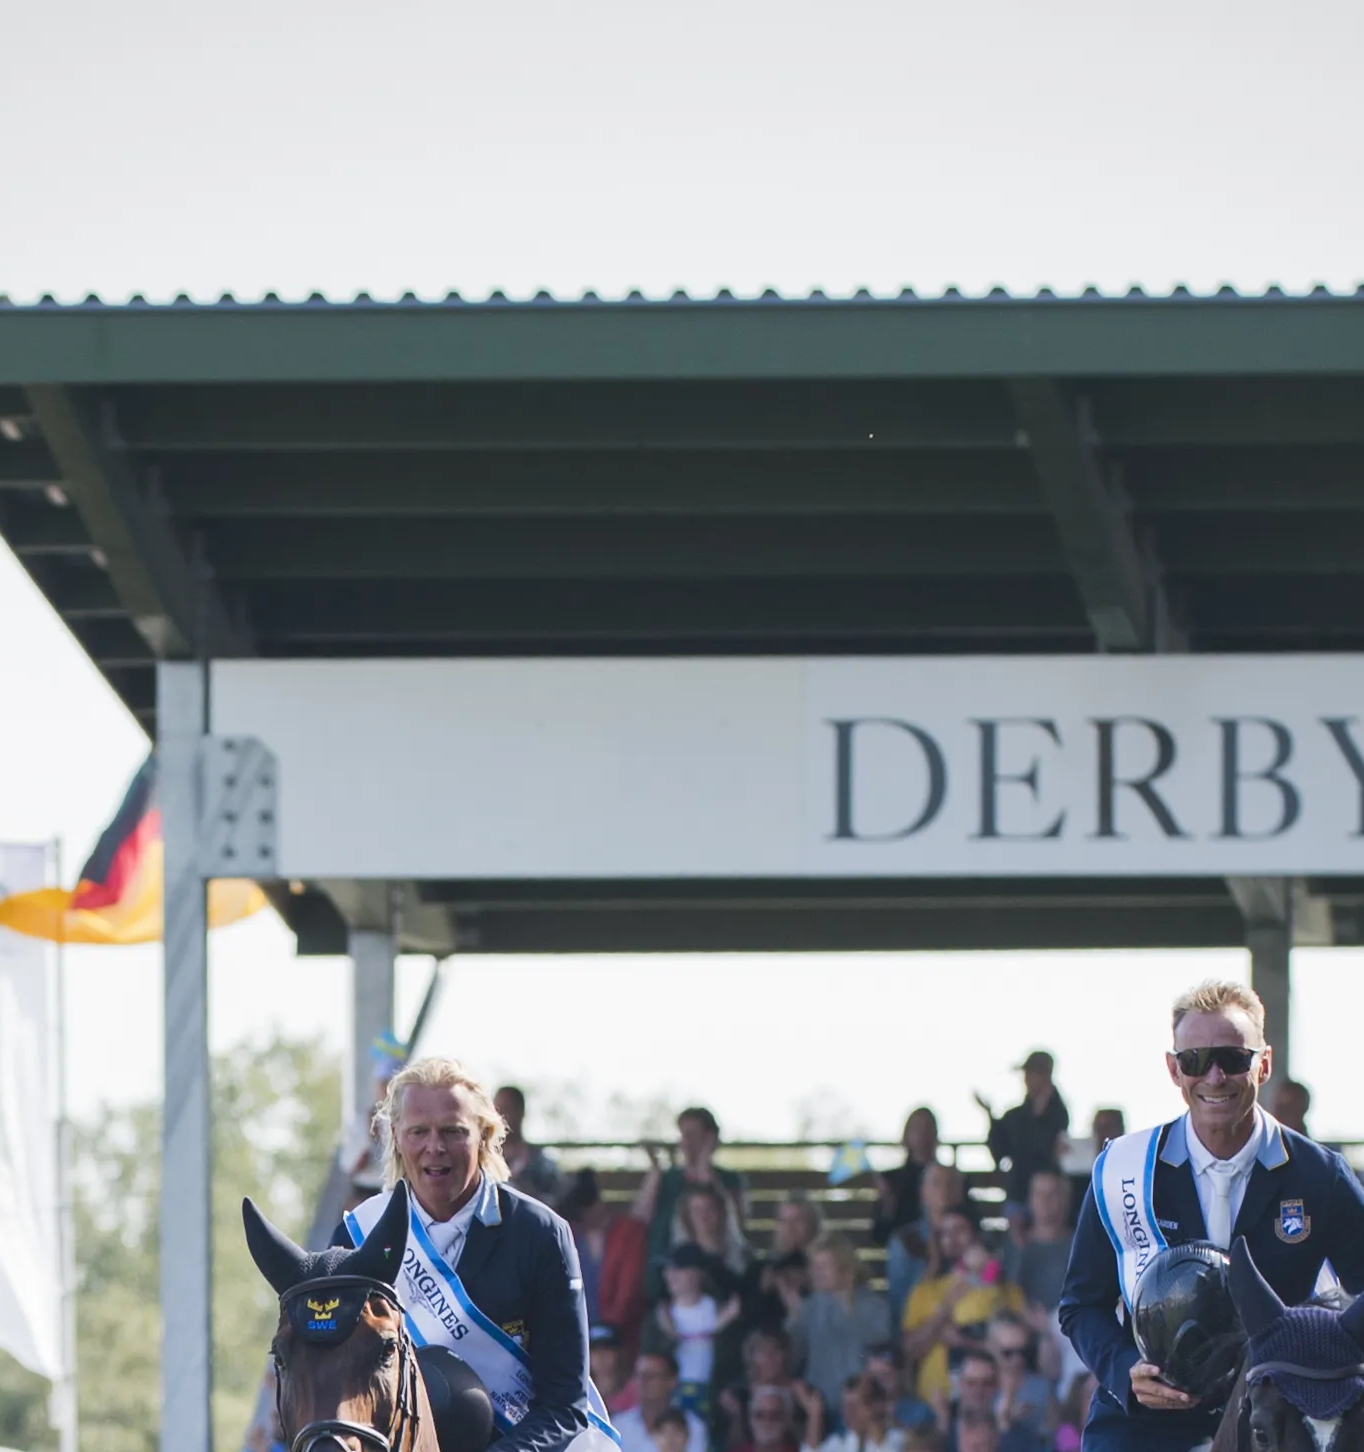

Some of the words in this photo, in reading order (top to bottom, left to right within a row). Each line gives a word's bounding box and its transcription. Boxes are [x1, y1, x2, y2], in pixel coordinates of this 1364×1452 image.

[1121, 1177, 1150, 1277] LONGIN
[307, 1320, 337, 1330] SWE
[403, 1247, 470, 1340] ONGINES
